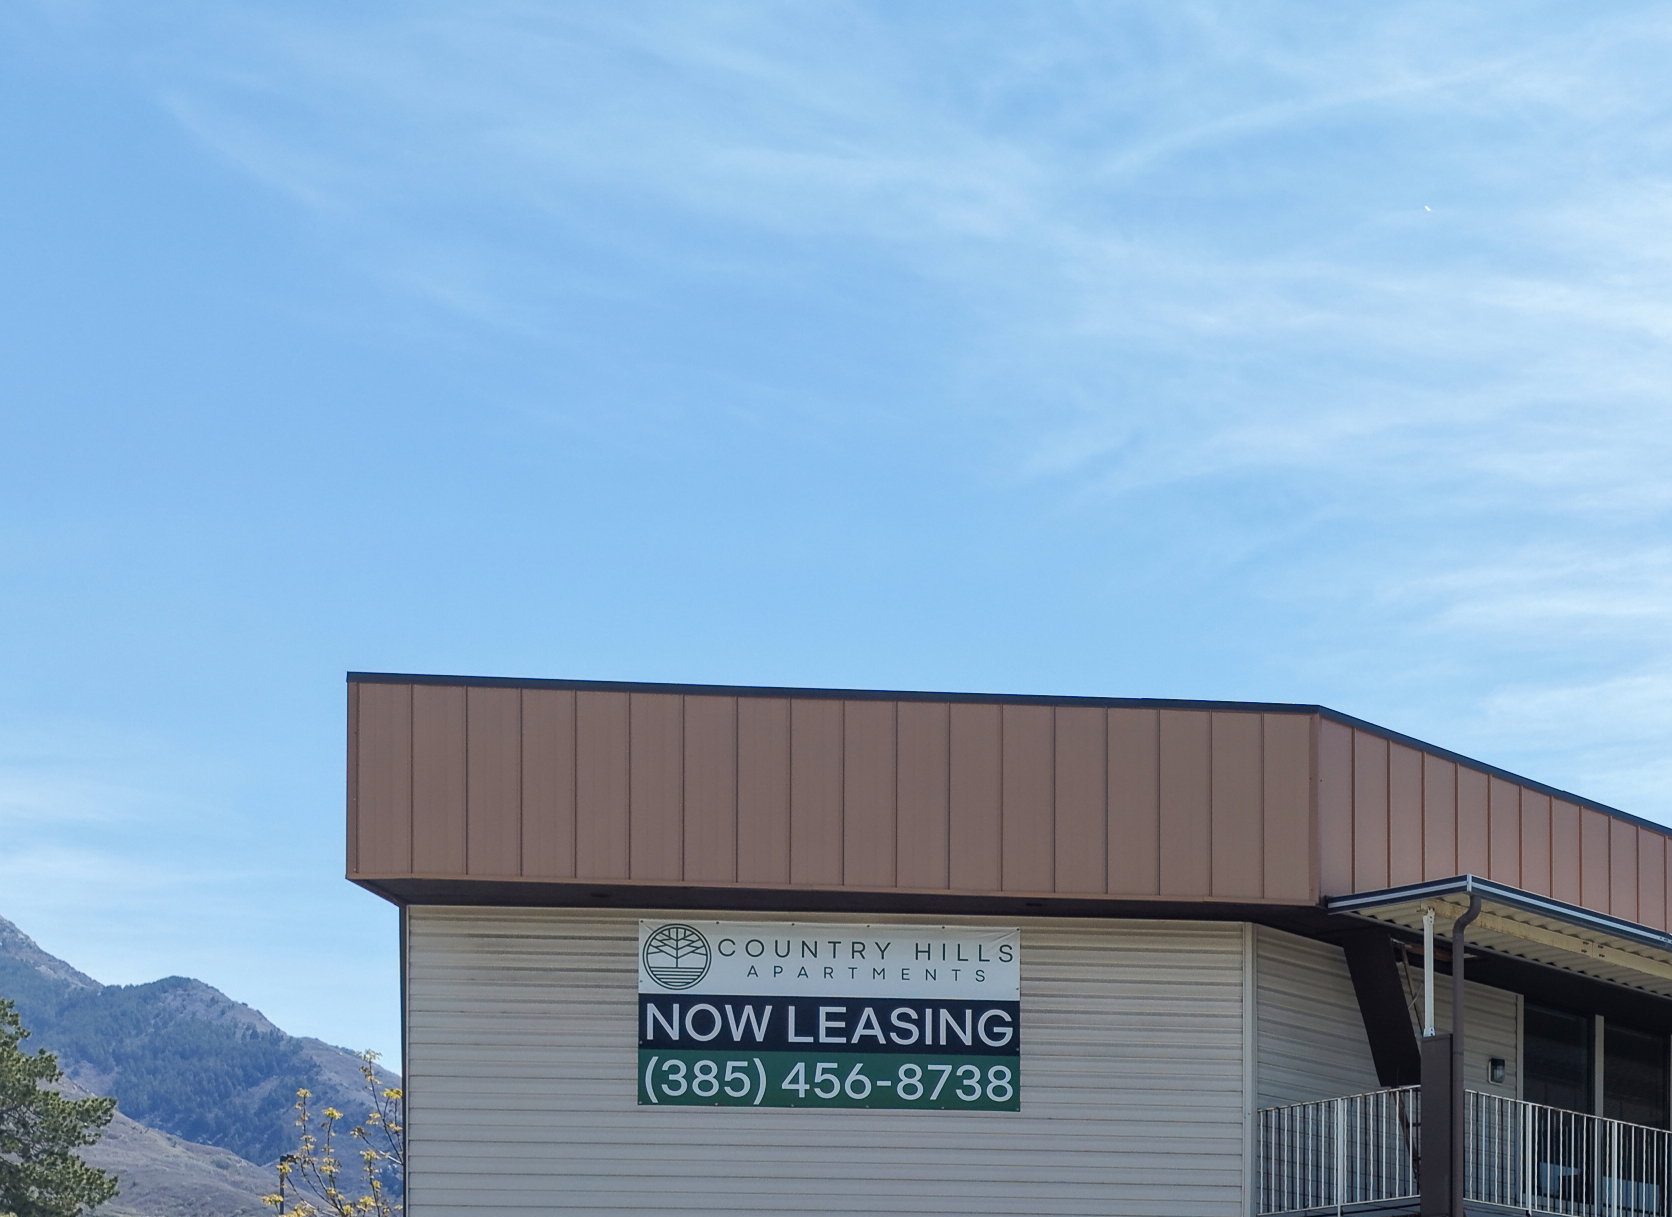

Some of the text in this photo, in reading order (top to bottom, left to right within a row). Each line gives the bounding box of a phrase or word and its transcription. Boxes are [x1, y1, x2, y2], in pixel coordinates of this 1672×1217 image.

[717, 938, 1014, 963] COUNTRY HILLS
[746, 964, 987, 983] APARTMENTS
[646, 1002, 1014, 1047] NOW LEASING
[644, 1055, 1013, 1105] (385) 456-8738
